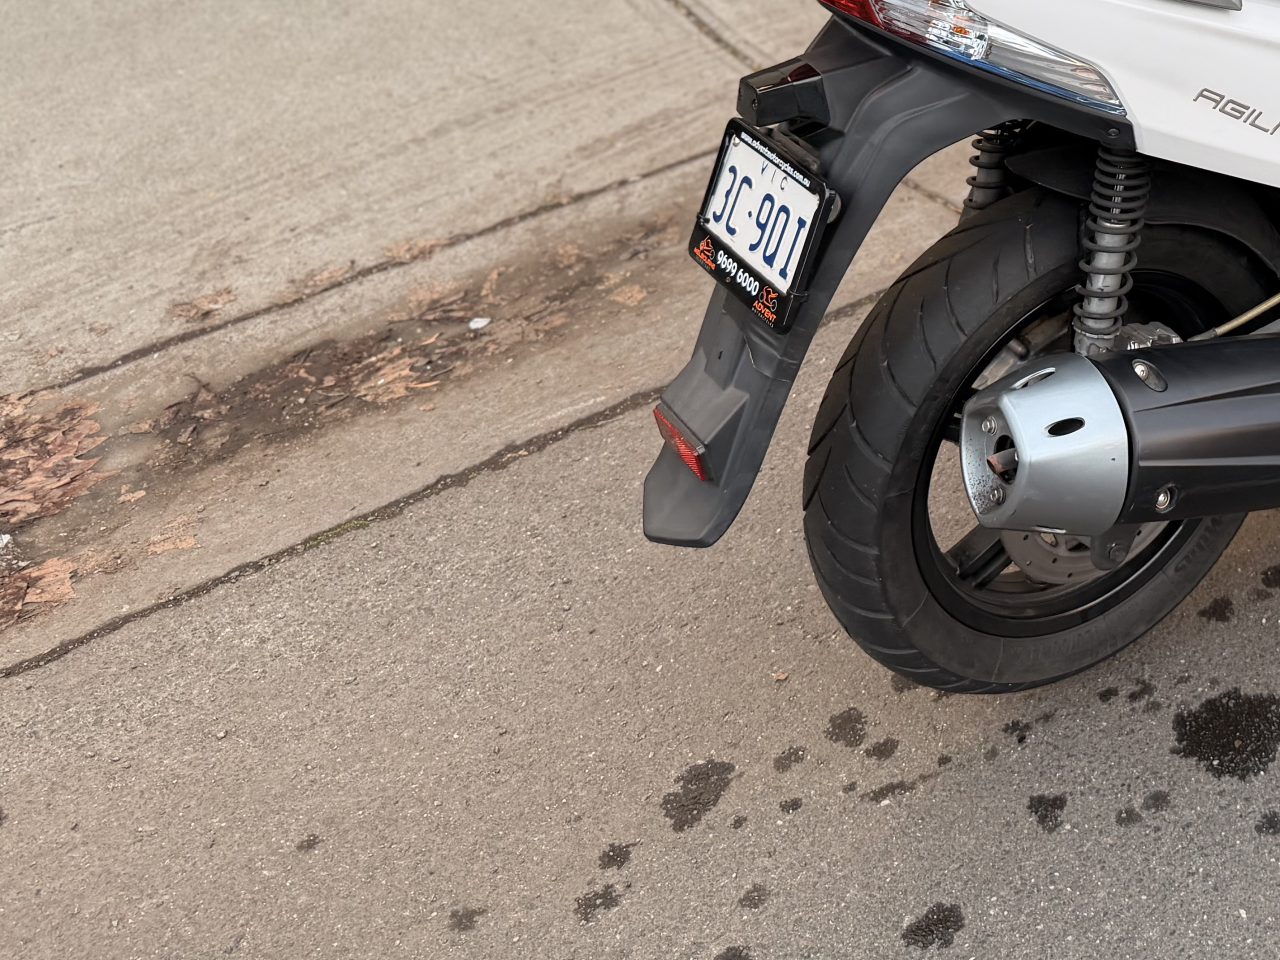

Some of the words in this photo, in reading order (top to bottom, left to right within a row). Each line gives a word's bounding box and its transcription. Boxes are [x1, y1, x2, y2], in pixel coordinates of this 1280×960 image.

[760, 160, 789, 191] VIC
[716, 249, 738, 277] 9699
[736, 268, 760, 296] 6000
[752, 300, 777, 323] ADVENT
